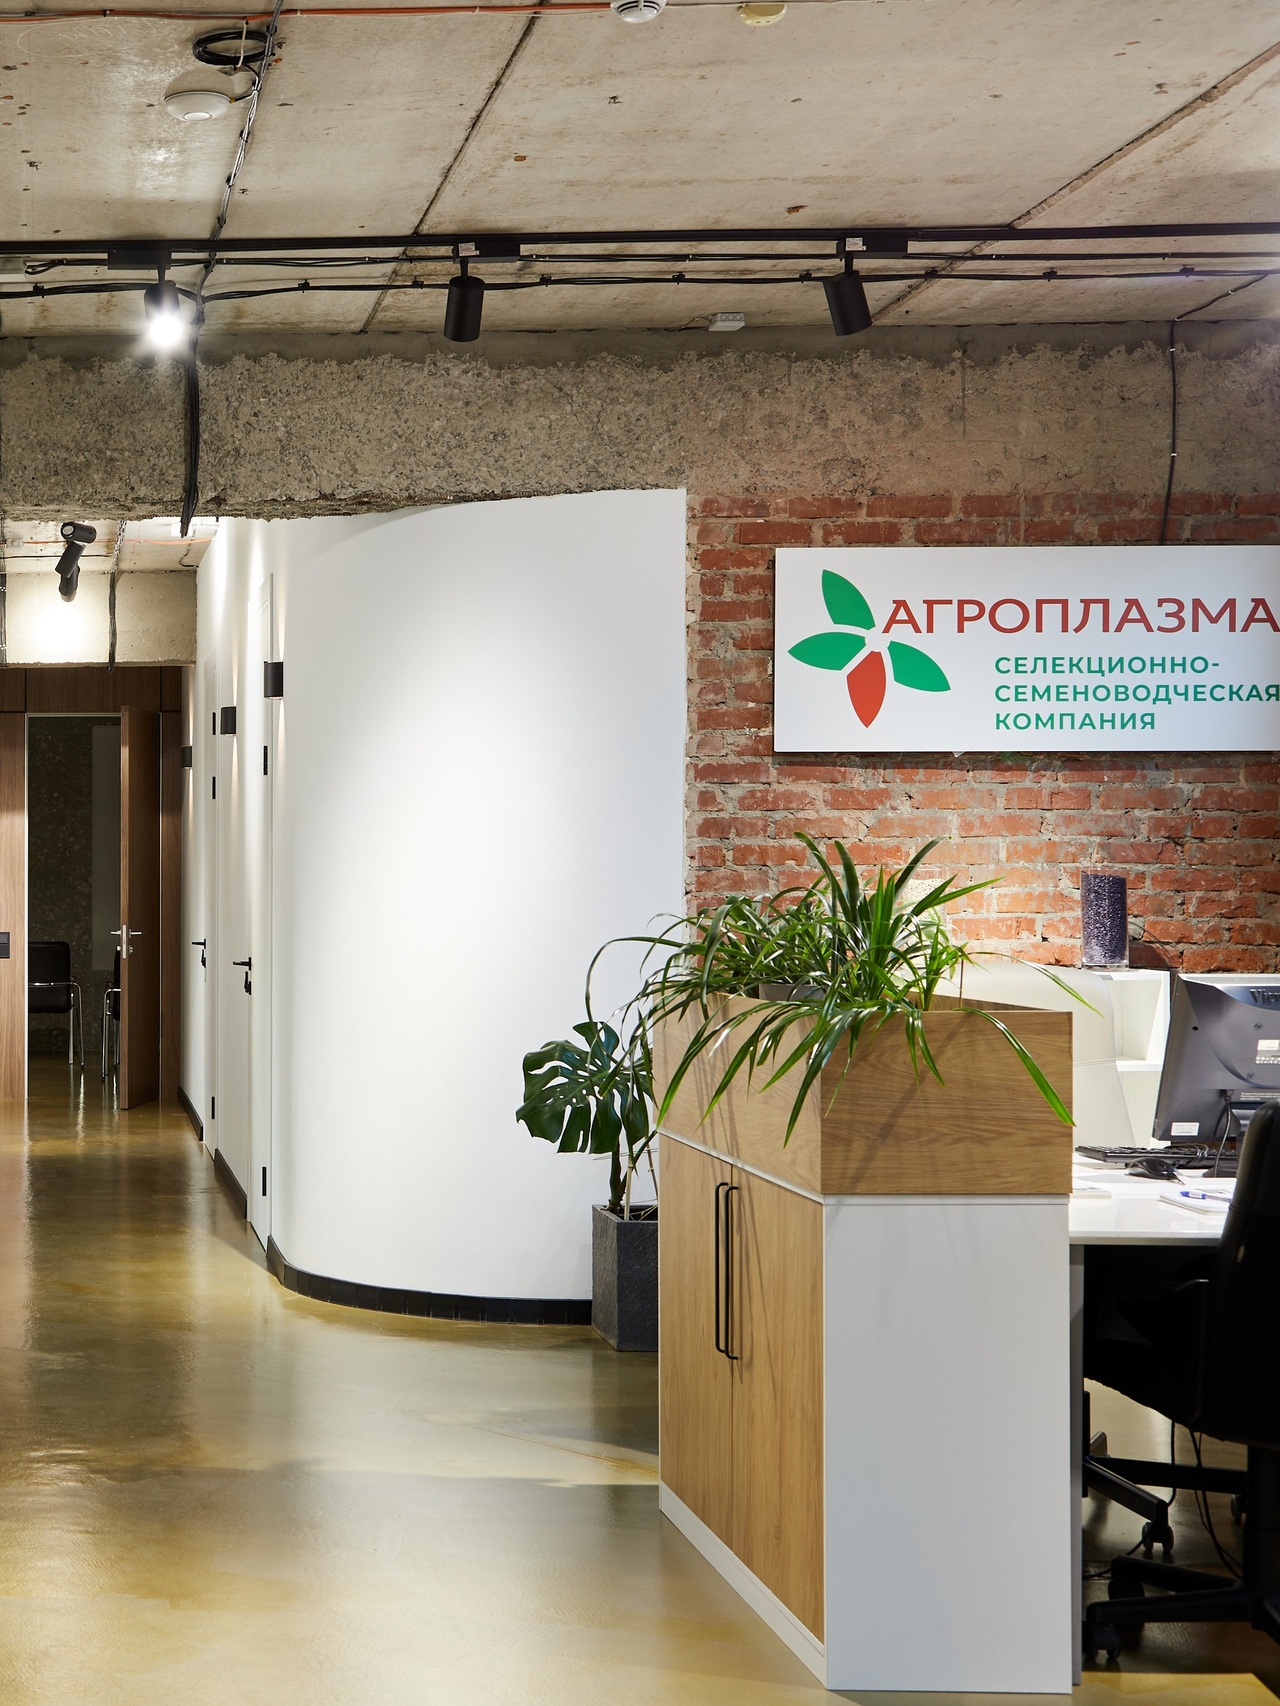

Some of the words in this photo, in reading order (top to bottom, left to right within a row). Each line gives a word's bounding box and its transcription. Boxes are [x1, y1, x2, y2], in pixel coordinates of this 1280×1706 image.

[882, 597, 1280, 634] АГРОПЛАЗМА
[995, 656, 1219, 677] СЕЛЕКЦИОННО-
[995, 684, 1280, 705] СЕМЕНОВОДЧЕСКАЯ
[995, 712, 1155, 730] КОМПАНИЯ
